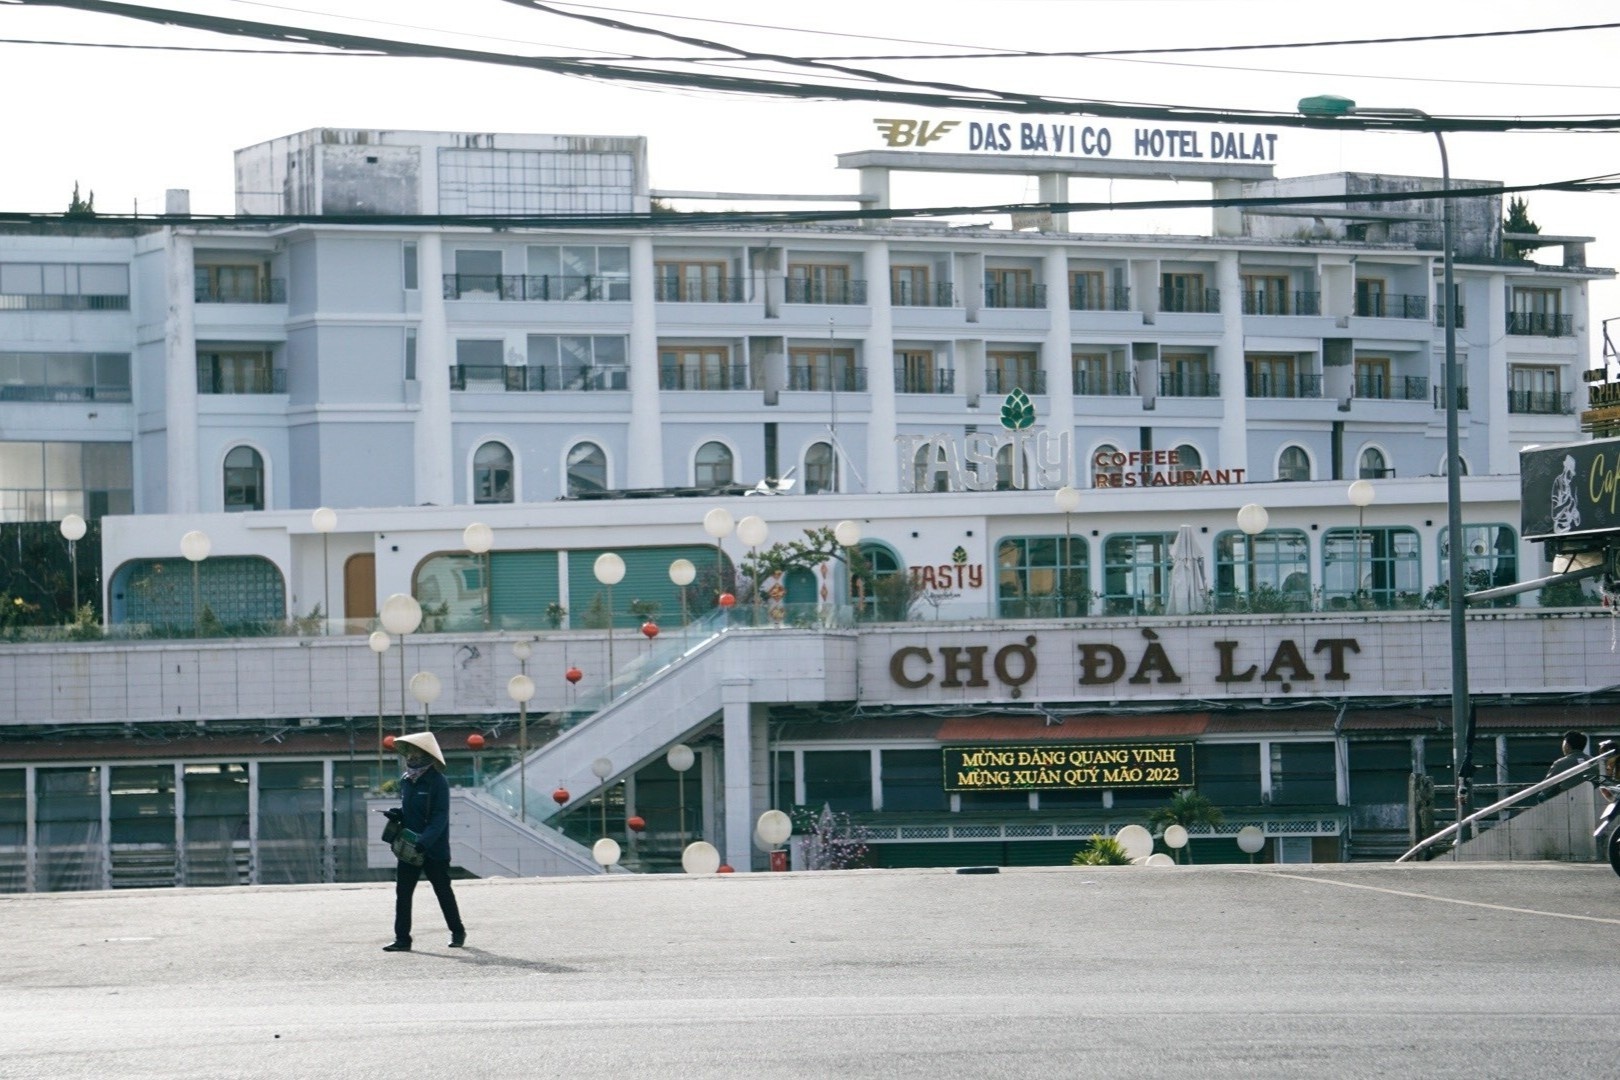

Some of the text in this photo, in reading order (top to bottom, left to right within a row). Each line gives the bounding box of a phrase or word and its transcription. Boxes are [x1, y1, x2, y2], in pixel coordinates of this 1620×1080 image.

[969, 121, 1012, 151] DAS
[1134, 128, 1203, 158] HOTEL
[1210, 131, 1278, 161] DALAT
[894, 431, 1072, 493] TASTY
[1095, 450, 1180, 467] COFFEE
[1095, 468, 1246, 488] RESTAURANT
[909, 564, 983, 590] TASTY
[889, 627, 1361, 699] CHỢ ĐÀ LẠT
[962, 748, 1176, 767] MỪNG ĐẢNG QUANG VINH
[1012, 767, 1061, 785] XUÂN
[1063, 766, 1100, 786] QUÝ
[1103, 765, 1142, 783] MÃO
[1145, 768, 1180, 782] 2023
